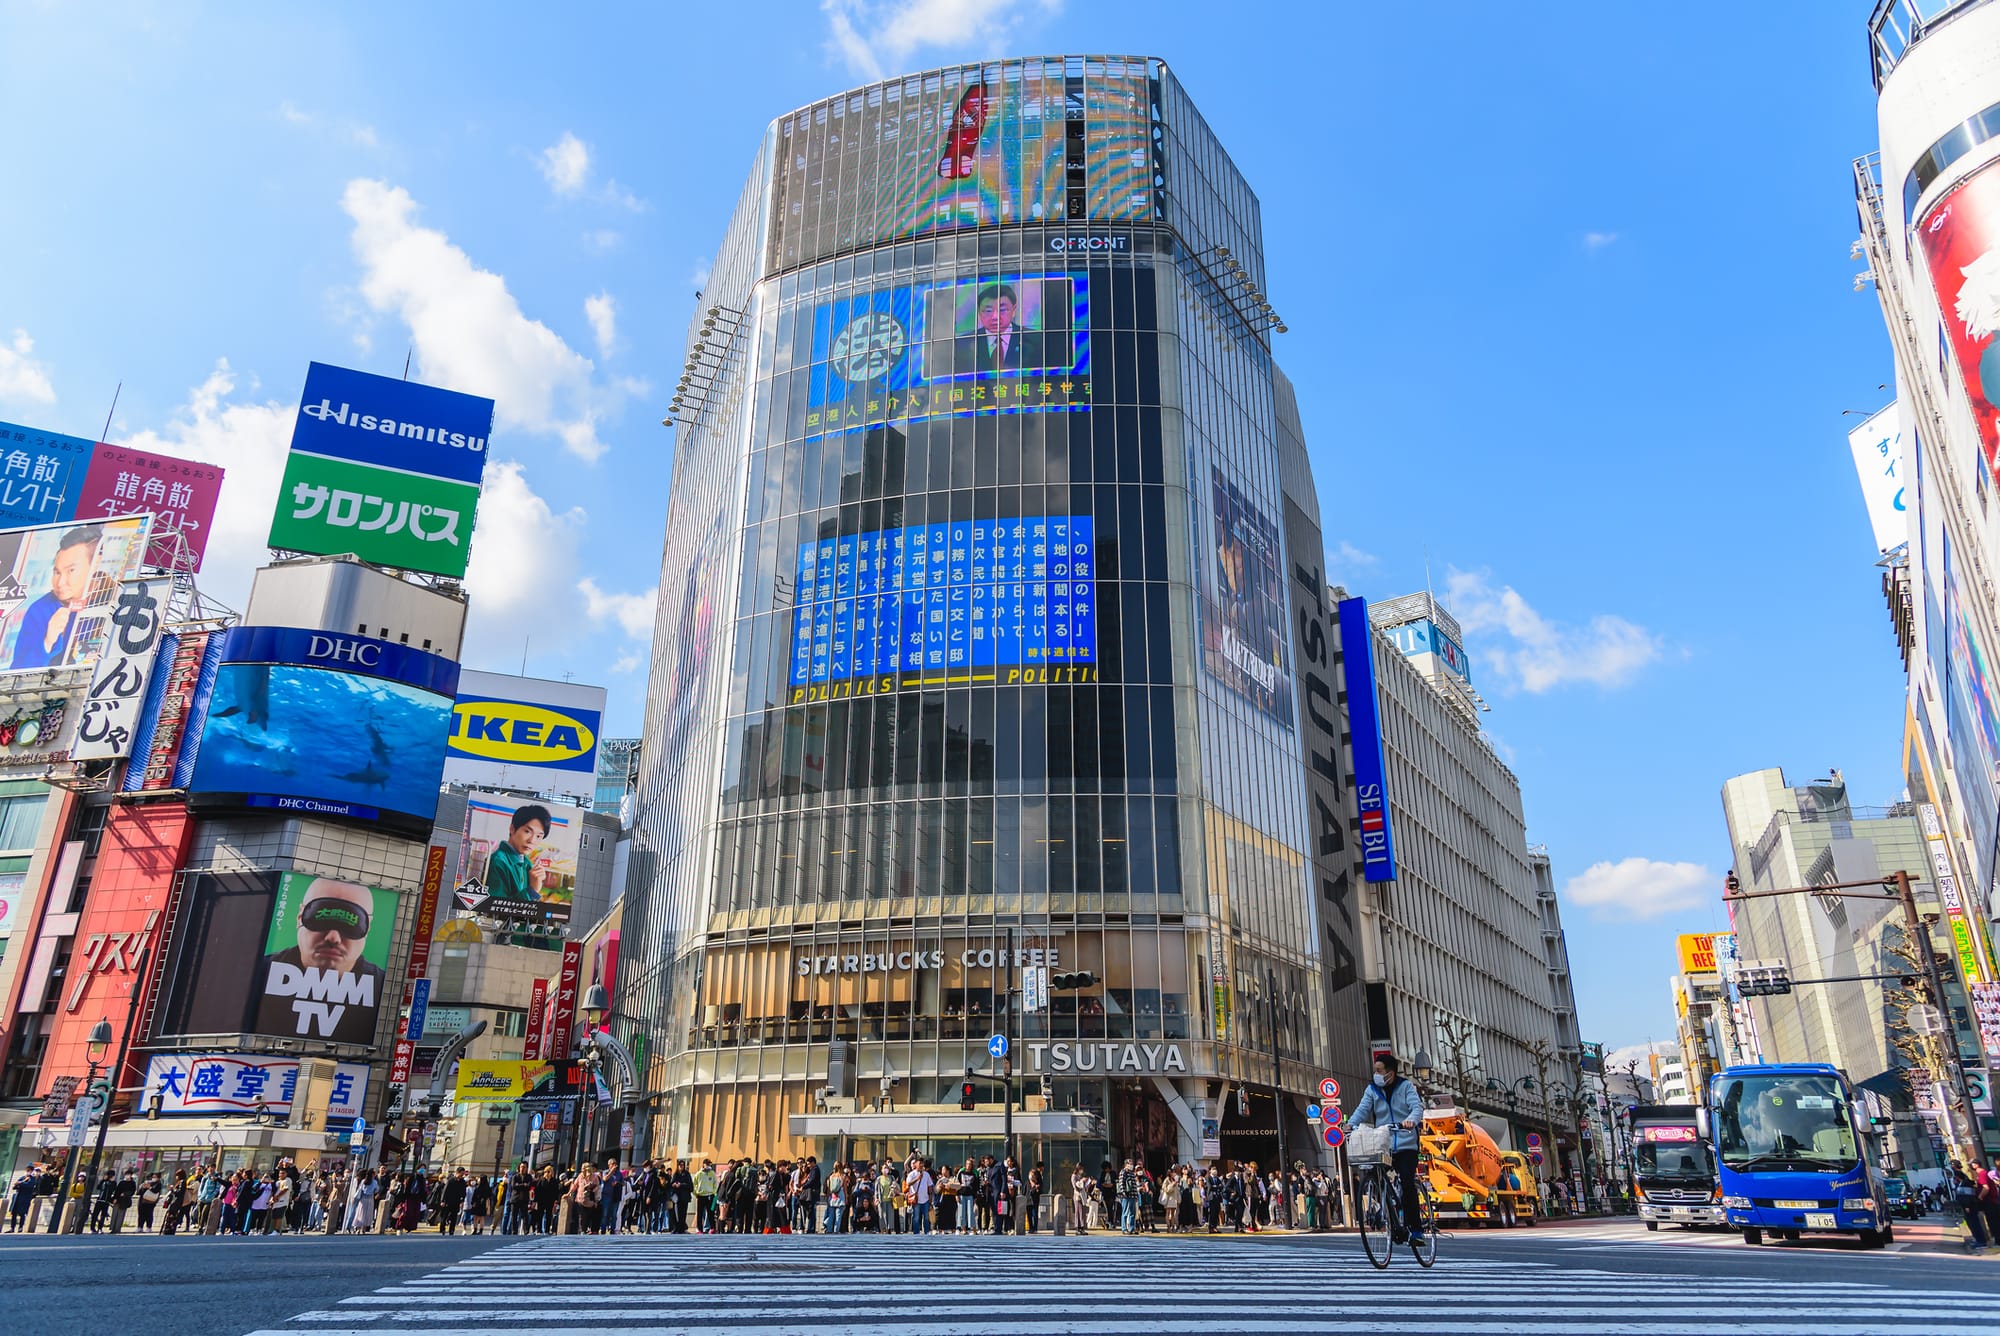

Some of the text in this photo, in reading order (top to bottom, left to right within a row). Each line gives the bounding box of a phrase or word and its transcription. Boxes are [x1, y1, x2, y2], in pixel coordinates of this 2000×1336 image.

[1051, 237, 1126, 253] QFRONT
[303, 399, 484, 452] Hisamitsu
[0, 449, 61, 483] 角散
[0, 478, 65, 513] レクト
[113, 471, 194, 510] 龍角散
[293, 481, 459, 546] サロンパス
[80, 582, 159, 754] もんじゃ
[307, 635, 381, 666] DHC
[793, 678, 891, 703] POLITICS
[450, 712, 582, 751] IKEA
[610, 740, 639, 751] PARC
[1296, 562, 1357, 992] TSUTAYA
[279, 798, 349, 815] DHC Channel
[1359, 784, 1386, 864] SEIBU
[419, 850, 442, 935] クスリのことなら
[797, 949, 1059, 976] STARBUCKS COFFEE
[265, 961, 374, 1008] DMM
[557, 952, 578, 1020] カラオケ
[292, 1000, 345, 1037] TV
[1029, 1043, 1186, 1071] TSUTAYA
